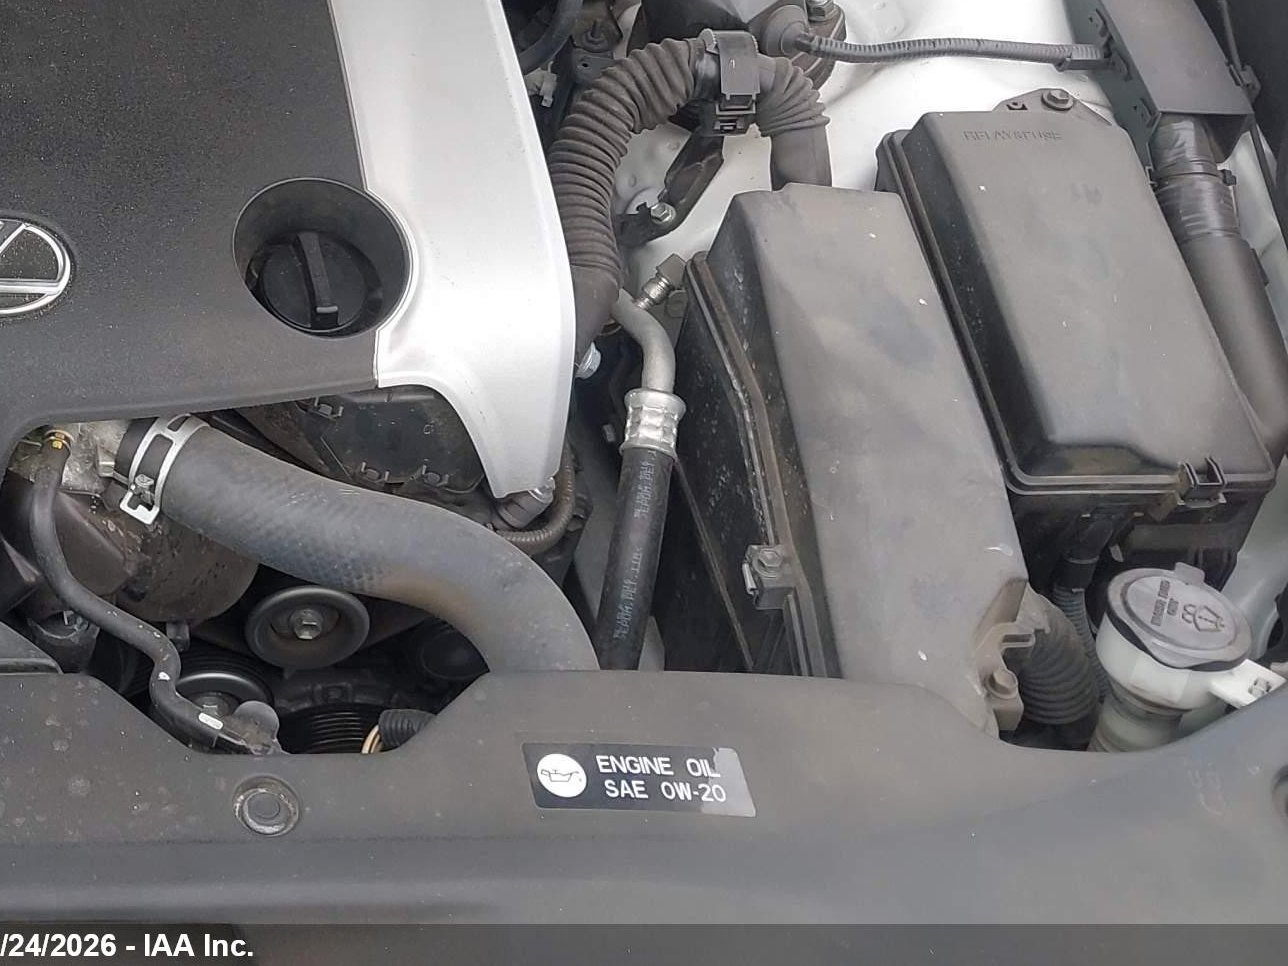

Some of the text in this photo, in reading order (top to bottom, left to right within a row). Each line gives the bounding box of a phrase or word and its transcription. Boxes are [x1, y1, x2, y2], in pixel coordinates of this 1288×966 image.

[596, 755, 721, 778] ENGINE OIL
[605, 780, 727, 803] SAE 0W-20
